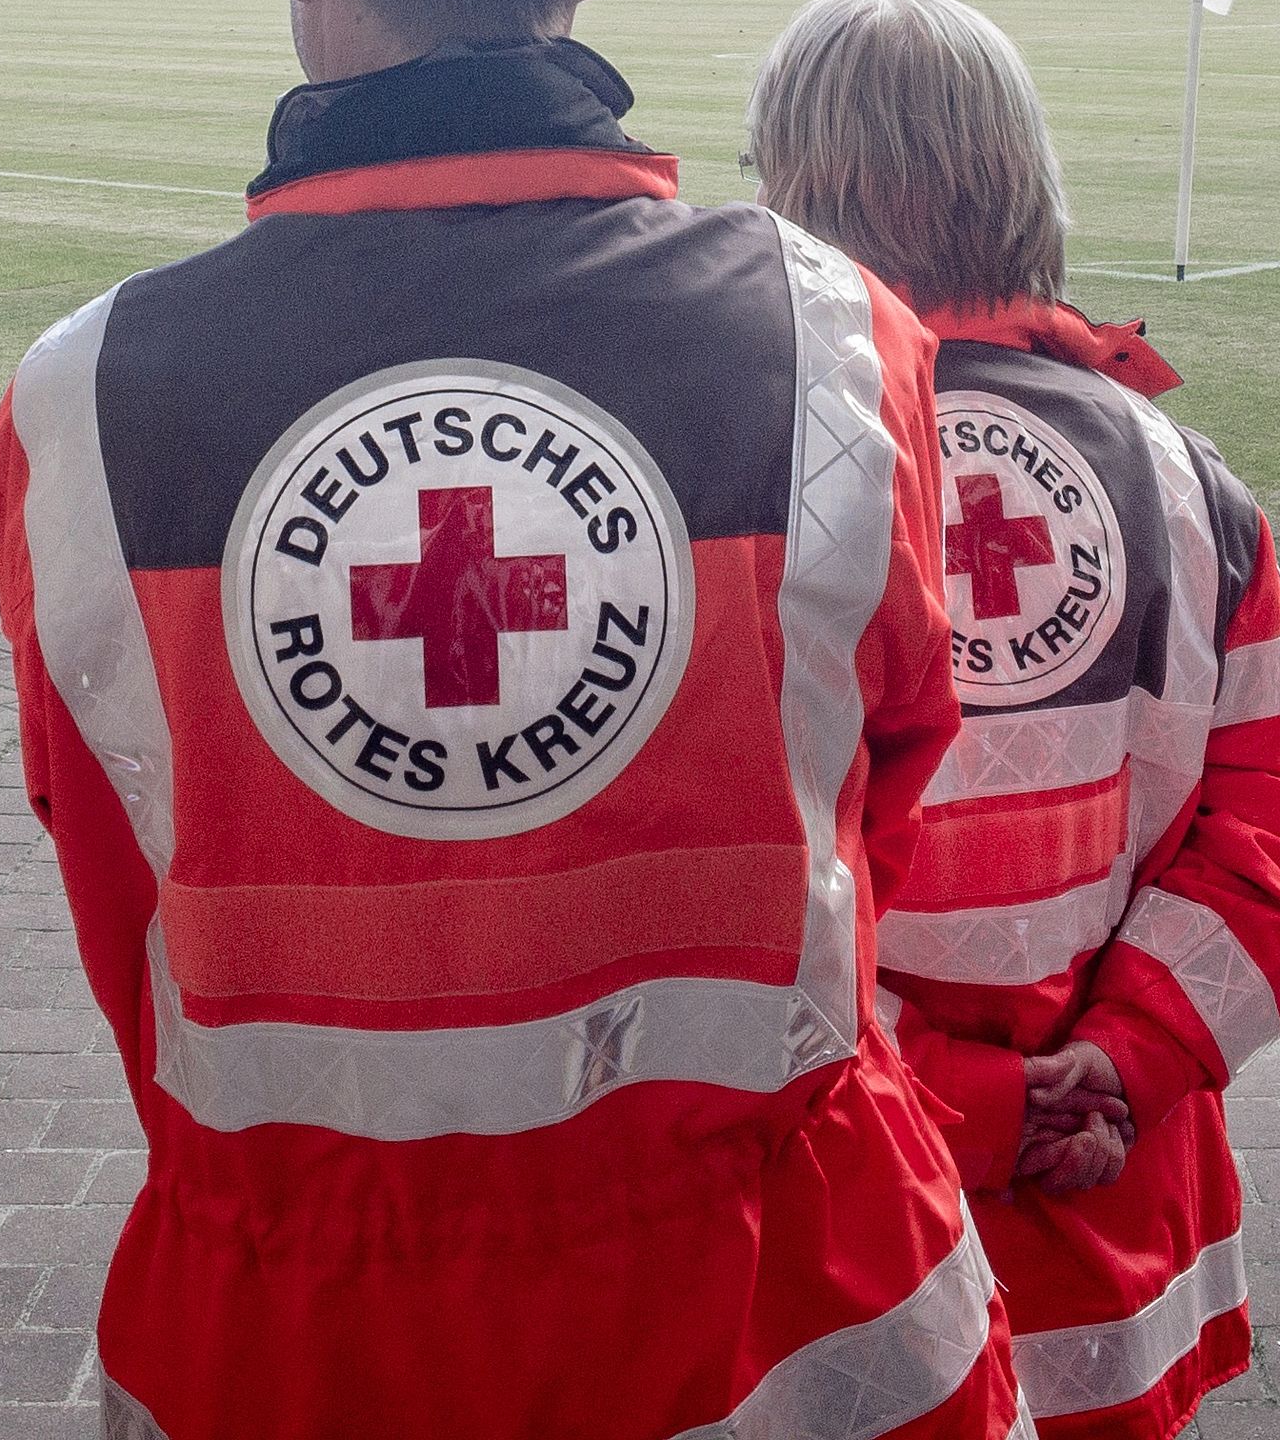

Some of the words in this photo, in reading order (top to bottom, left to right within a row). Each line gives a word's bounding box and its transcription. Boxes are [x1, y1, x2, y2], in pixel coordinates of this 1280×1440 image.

[276, 407, 638, 568] DEUTSCHES
[938, 421, 1082, 514] TSCHES
[1009, 543, 1102, 670] KREUZ
[270, 614, 447, 792] ROTES
[475, 601, 650, 791] KREUZ
